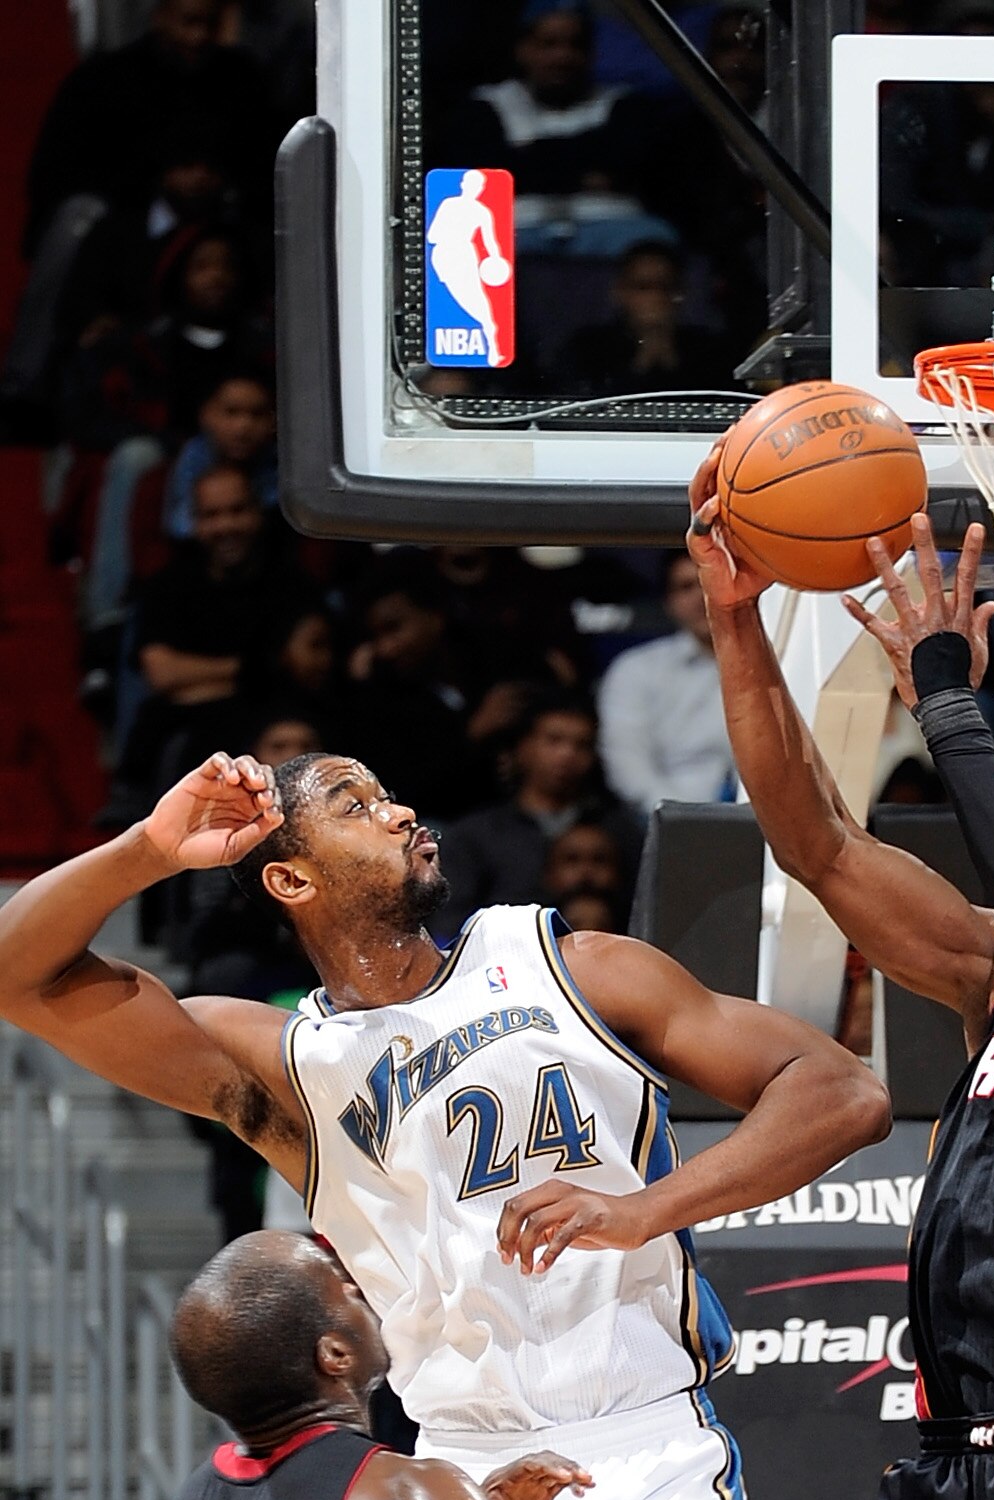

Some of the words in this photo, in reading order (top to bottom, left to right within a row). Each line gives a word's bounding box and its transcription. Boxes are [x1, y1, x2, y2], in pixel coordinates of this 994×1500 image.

[435, 328, 487, 356] NBA
[764, 405, 904, 460] ALDING
[446, 1062, 603, 1202] 24
